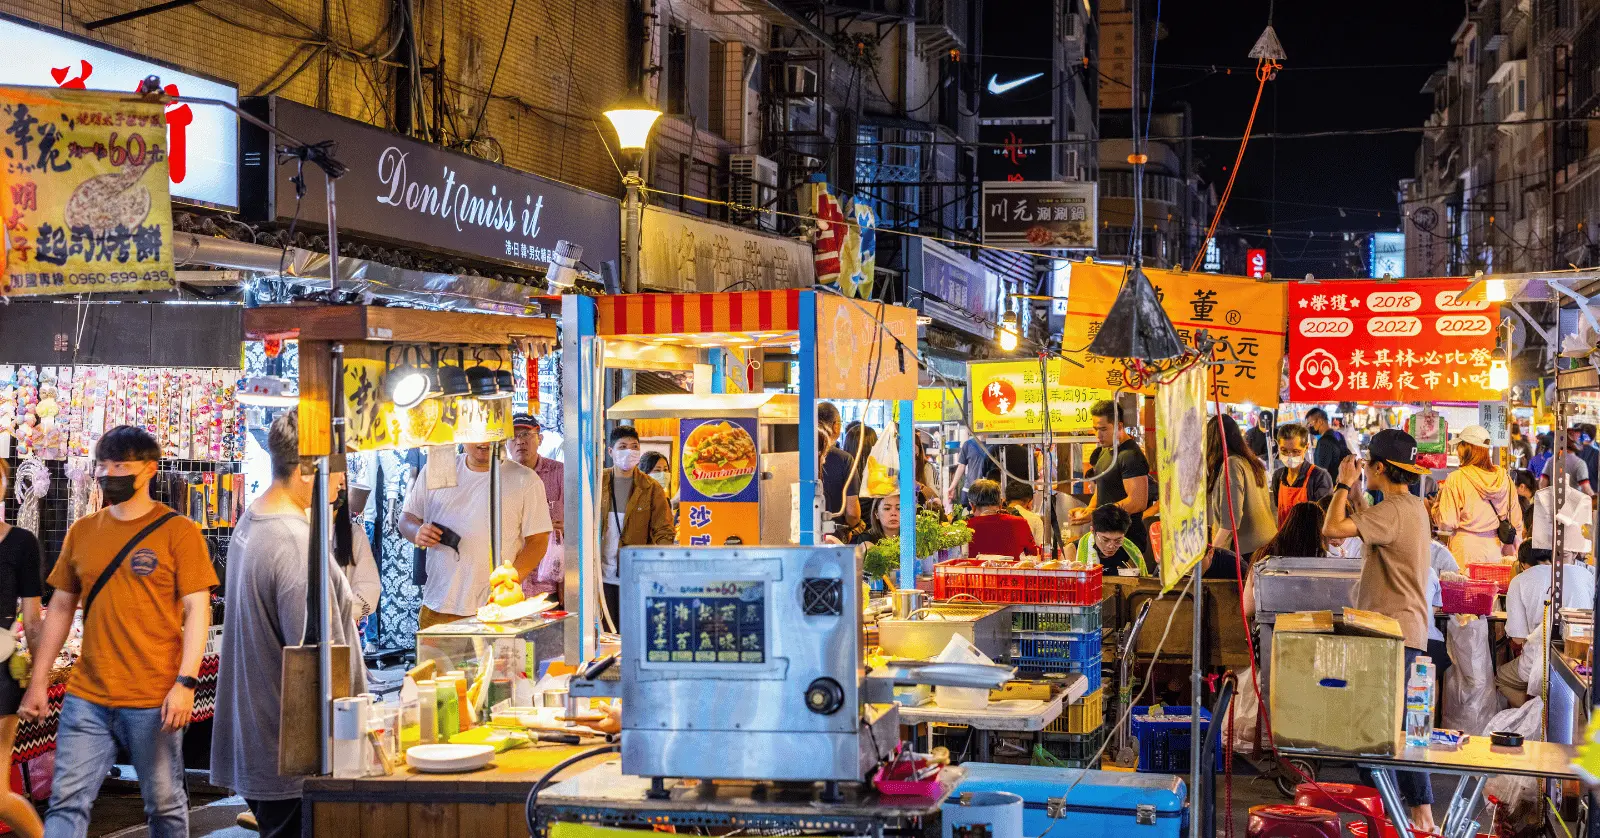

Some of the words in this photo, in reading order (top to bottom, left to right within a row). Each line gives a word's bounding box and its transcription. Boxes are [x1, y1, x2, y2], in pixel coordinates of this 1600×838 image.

[377, 146, 456, 218] Don't
[453, 184, 516, 232] miss
[522, 194, 544, 239] it
[991, 198, 1033, 223] 川元
[1310, 294, 1351, 312] 榮獲
[1372, 295, 1416, 309] 2018
[1304, 320, 1350, 334] 2020
[1372, 320, 1418, 334] 2021
[1440, 319, 1489, 332] 2022
[1349, 348, 1491, 367] 米其林必比登
[1348, 371, 1491, 391] 推薦夜市小吃
[692, 466, 755, 481] Shawarma
